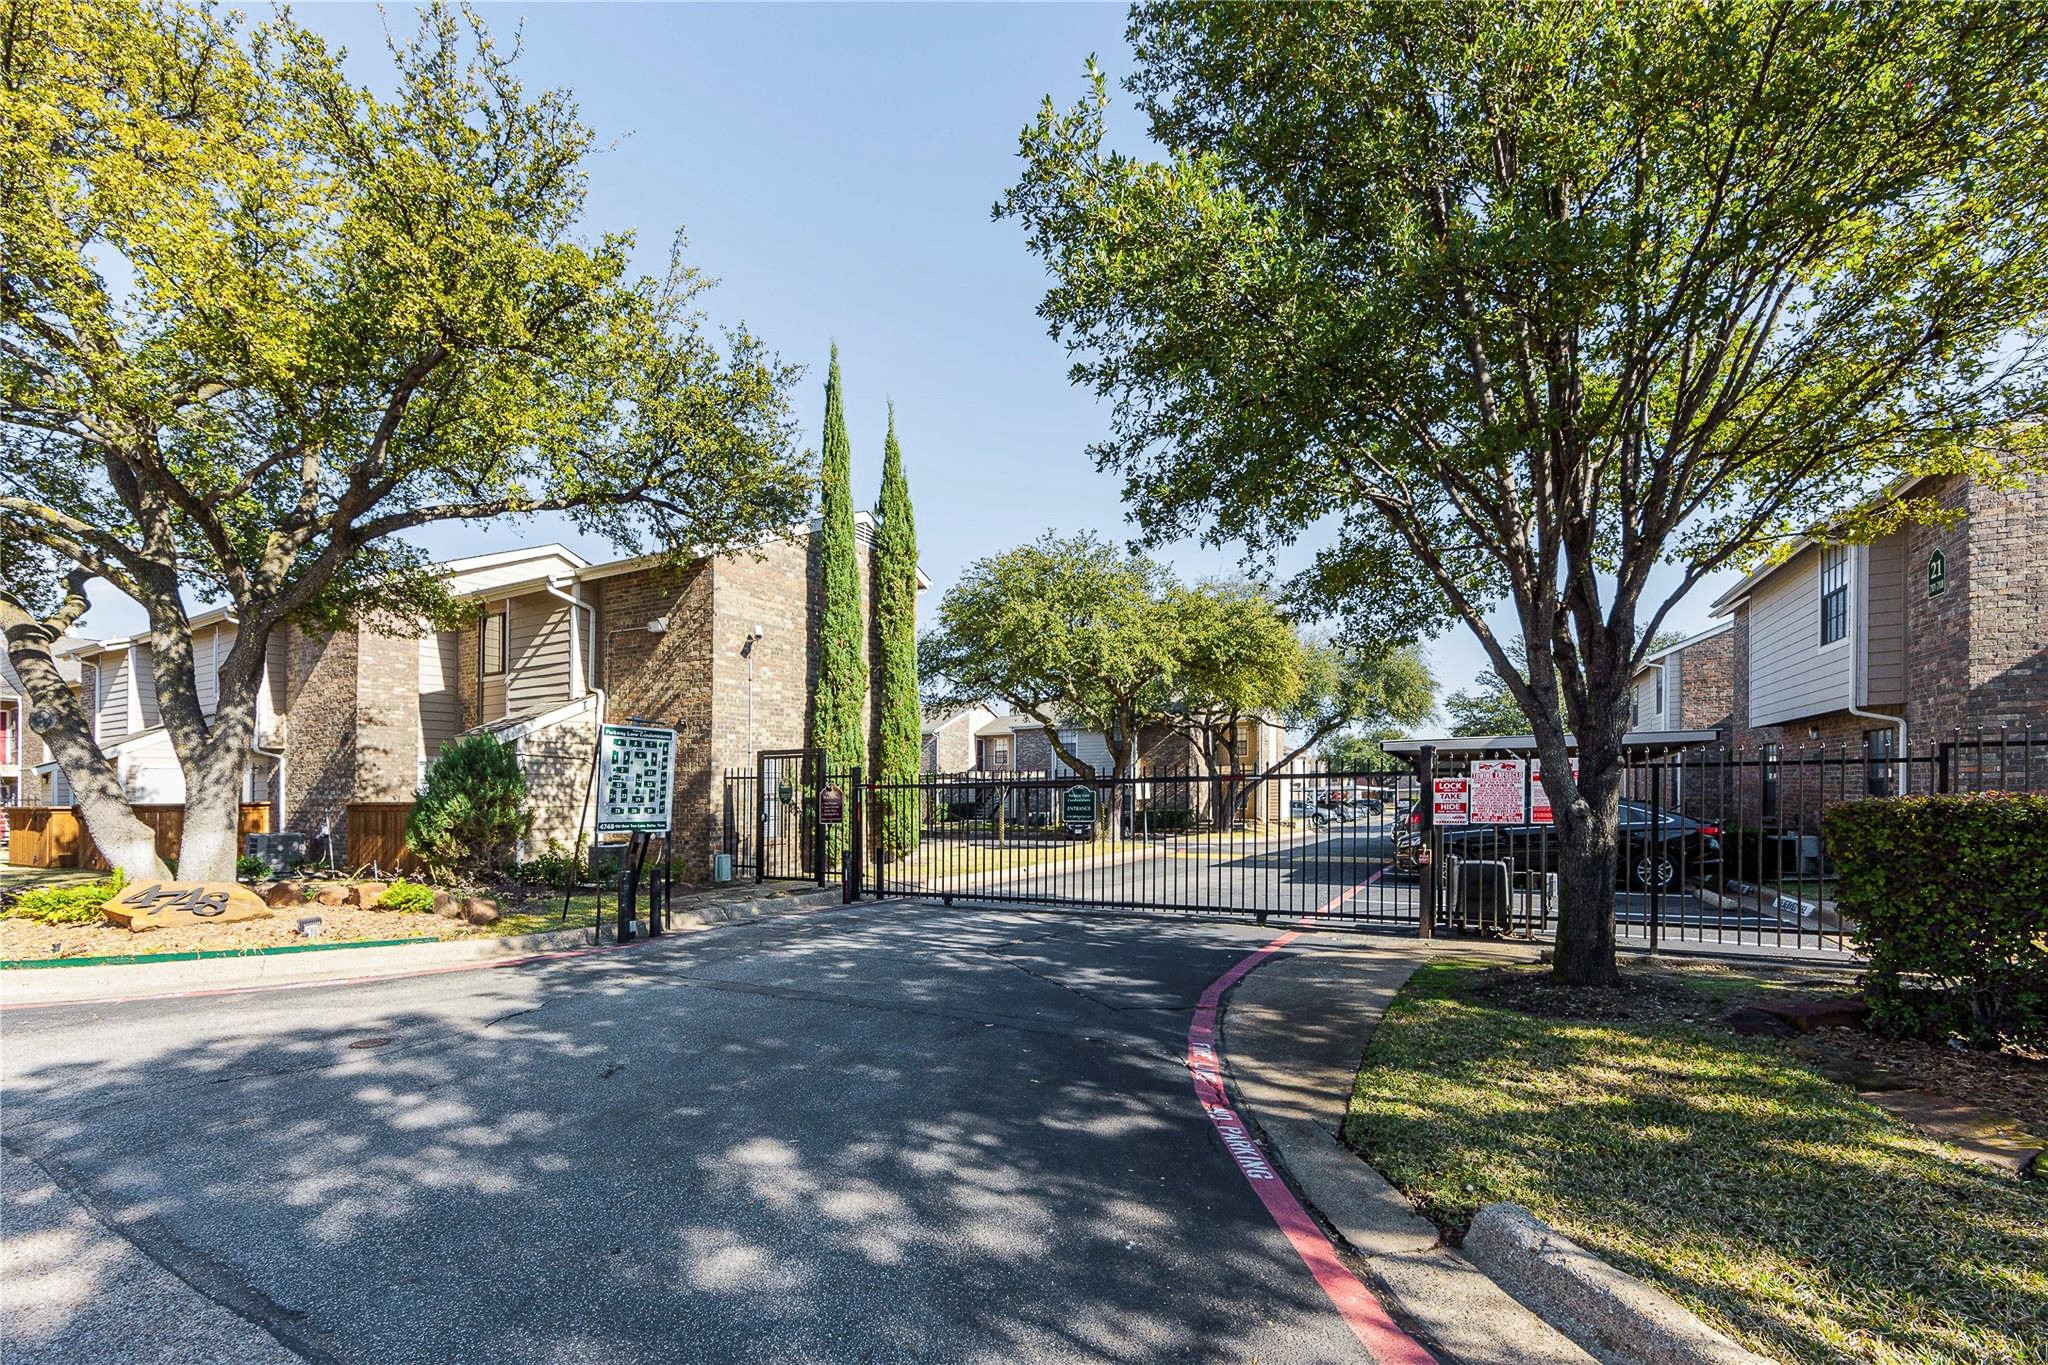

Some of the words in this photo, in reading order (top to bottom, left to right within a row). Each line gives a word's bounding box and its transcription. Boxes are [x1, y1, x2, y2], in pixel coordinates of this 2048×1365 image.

[1930, 560, 1942, 579] 21
[122, 884, 229, 917] 4748
[1218, 1125, 1273, 1180] PARKING
